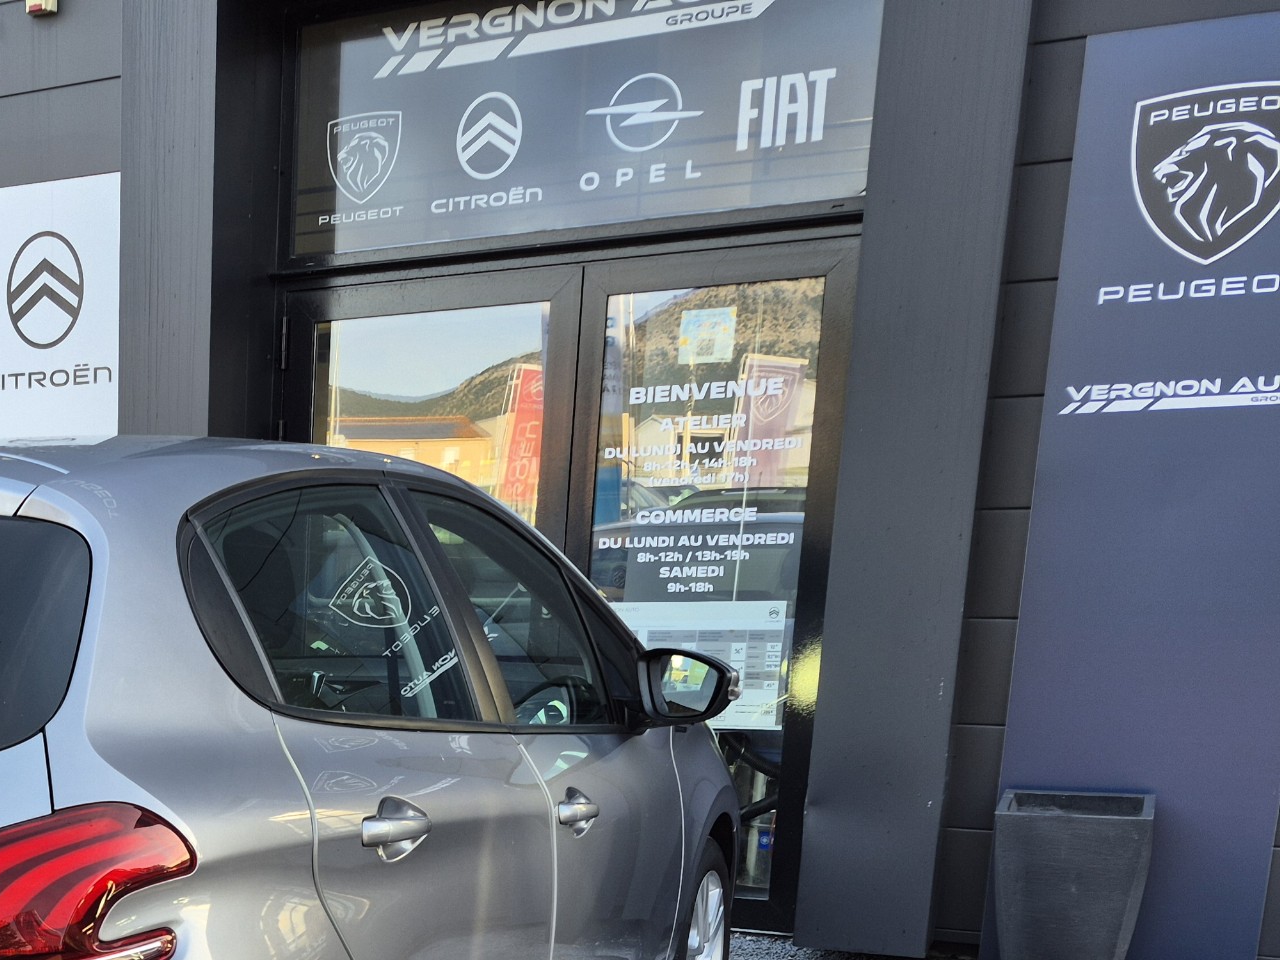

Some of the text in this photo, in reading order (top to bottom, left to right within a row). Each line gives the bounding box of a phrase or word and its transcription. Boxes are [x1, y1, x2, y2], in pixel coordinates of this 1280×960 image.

[665, 2, 753, 26] GROUPE
[382, 0, 616, 52] VERGNON
[735, 67, 837, 152] FIAT
[333, 117, 395, 134] PEUGEOT
[579, 159, 702, 191] OPEL
[318, 206, 404, 226] PEUGEOT
[628, 377, 785, 405] BIENVENUE
[1066, 378, 1222, 401] VERGNON
[658, 413, 747, 432] ATELIER
[604, 437, 803, 459] DU LUNDI AU VENDREDI
[635, 507, 758, 525] COMMERCE
[598, 532, 795, 550] DU LUNDI AU VENDREDI
[636, 551, 683, 564] 8h-12h
[695, 550, 751, 562] 13h-19h
[658, 566, 725, 579] SAMEDI
[667, 582, 714, 594] 9h-18h
